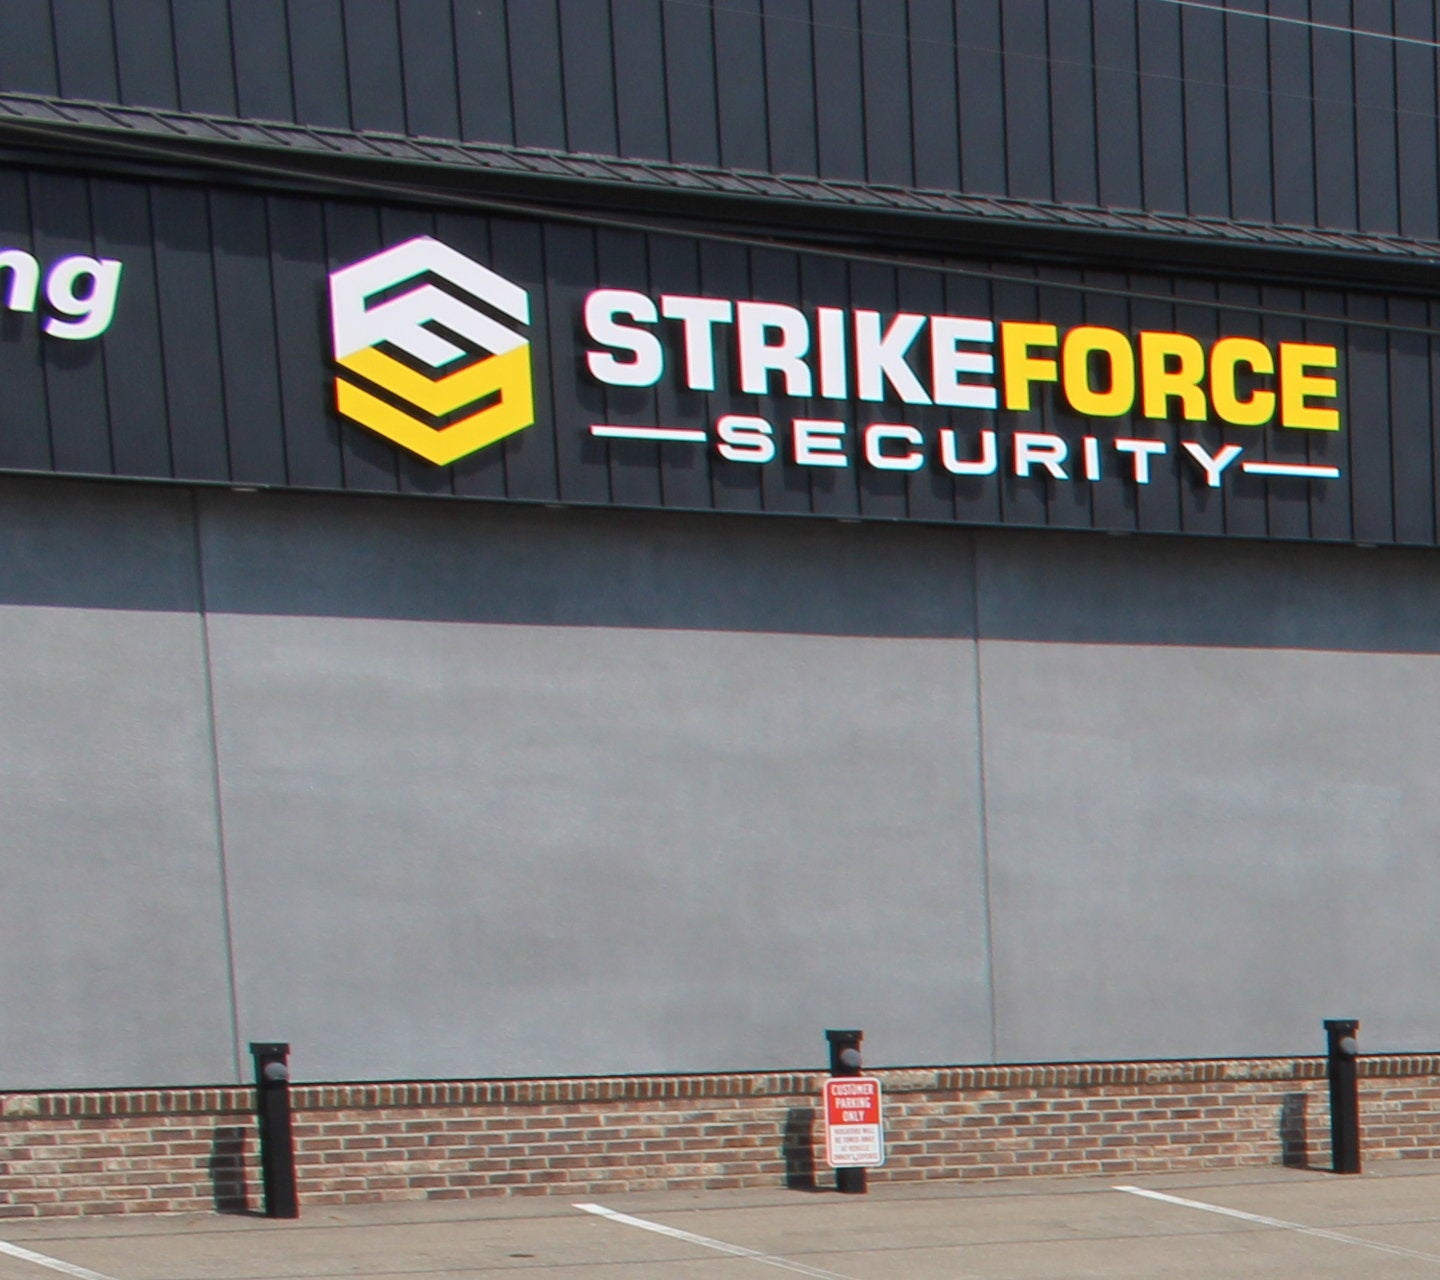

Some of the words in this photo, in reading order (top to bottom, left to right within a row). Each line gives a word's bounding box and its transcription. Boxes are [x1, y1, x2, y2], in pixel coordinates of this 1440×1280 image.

[584, 289, 1340, 431] STRIKEFORCE
[716, 415, 1242, 488] SECURITY
[831, 1083, 874, 1096] CUSTOMER
[835, 1097, 871, 1109] PARKING
[842, 1110, 865, 1122] ONLY
